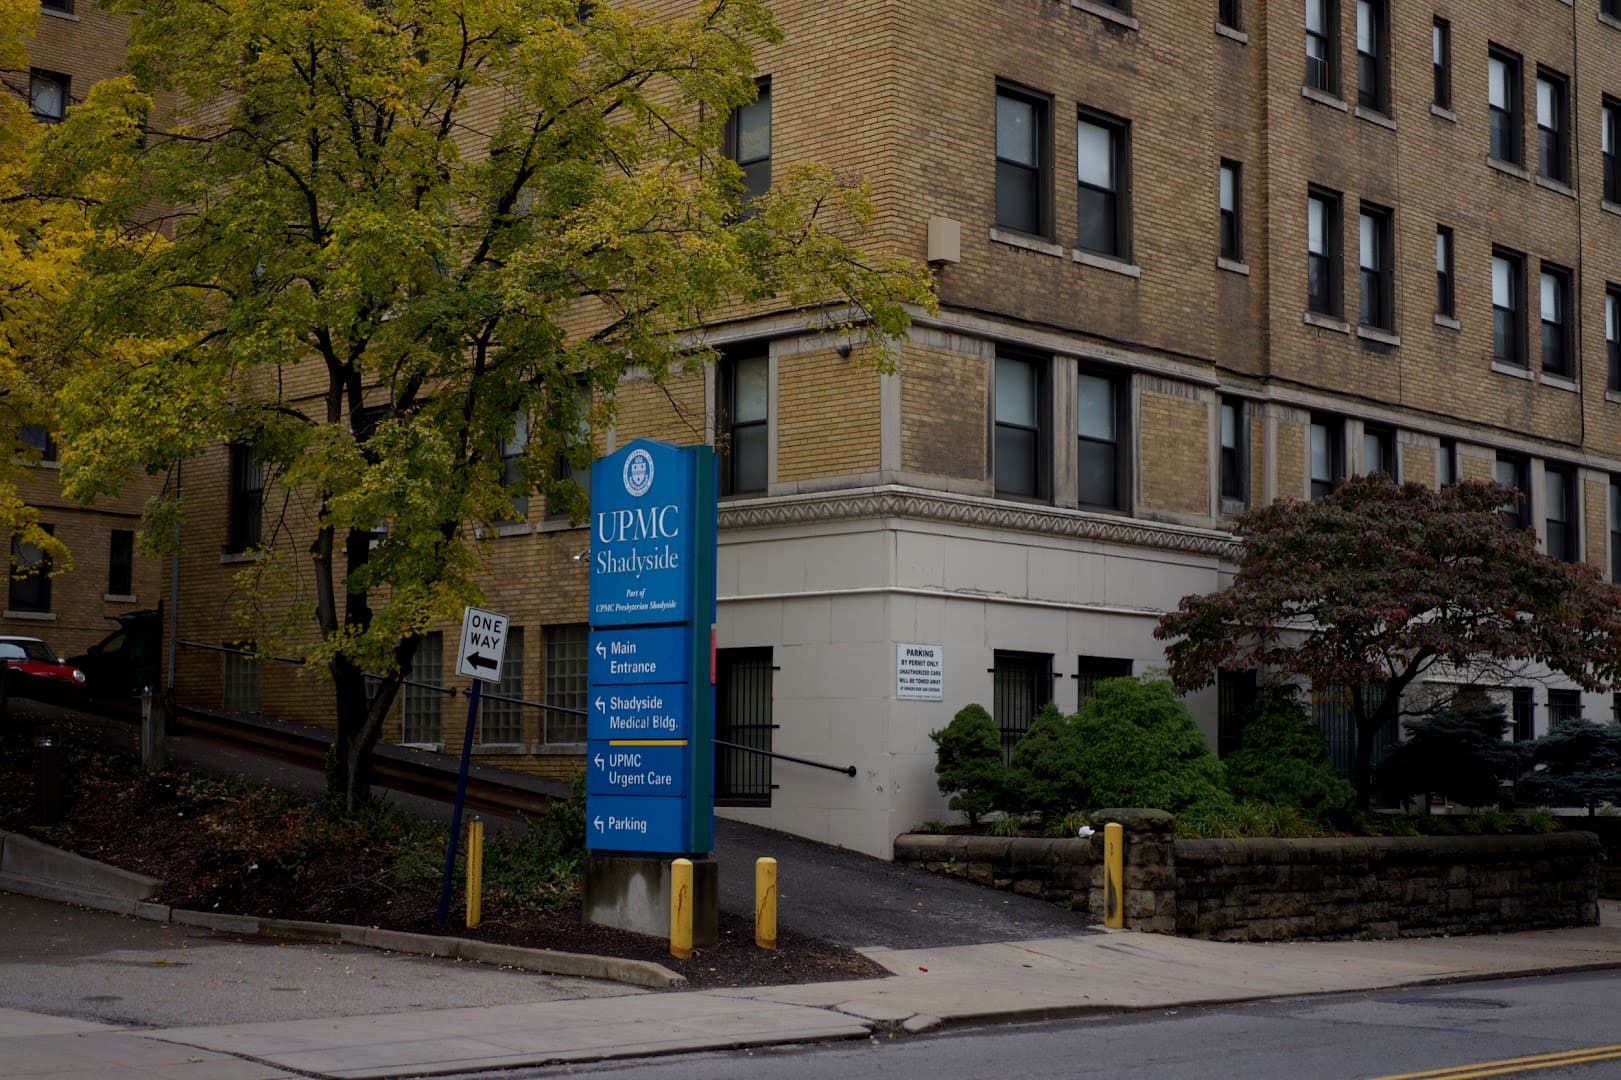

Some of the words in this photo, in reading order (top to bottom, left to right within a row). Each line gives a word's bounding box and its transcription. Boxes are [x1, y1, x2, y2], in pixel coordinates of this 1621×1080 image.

[597, 504, 679, 543] UPMC
[596, 545, 679, 579] Shadyside
[626, 588, 638, 598] Part
[639, 587, 647, 599] of
[595, 603, 615, 613] UPMC
[615, 602, 648, 614] Presbyterian
[649, 599, 677, 612] Shadyside
[472, 615, 502, 634] ONE
[471, 631, 500, 650] WAY
[611, 641, 637, 655] Main
[906, 649, 934, 657] PARKING
[610, 661, 657, 675] Entrance
[610, 695, 663, 712] Shadyside
[610, 715, 650, 729] Medical
[652, 714, 679, 731] Bldg.
[609, 753, 642, 767] UPMC
[609, 771, 645, 788] Urgent
[647, 771, 672, 785] Care
[608, 816, 647, 834] Parking
